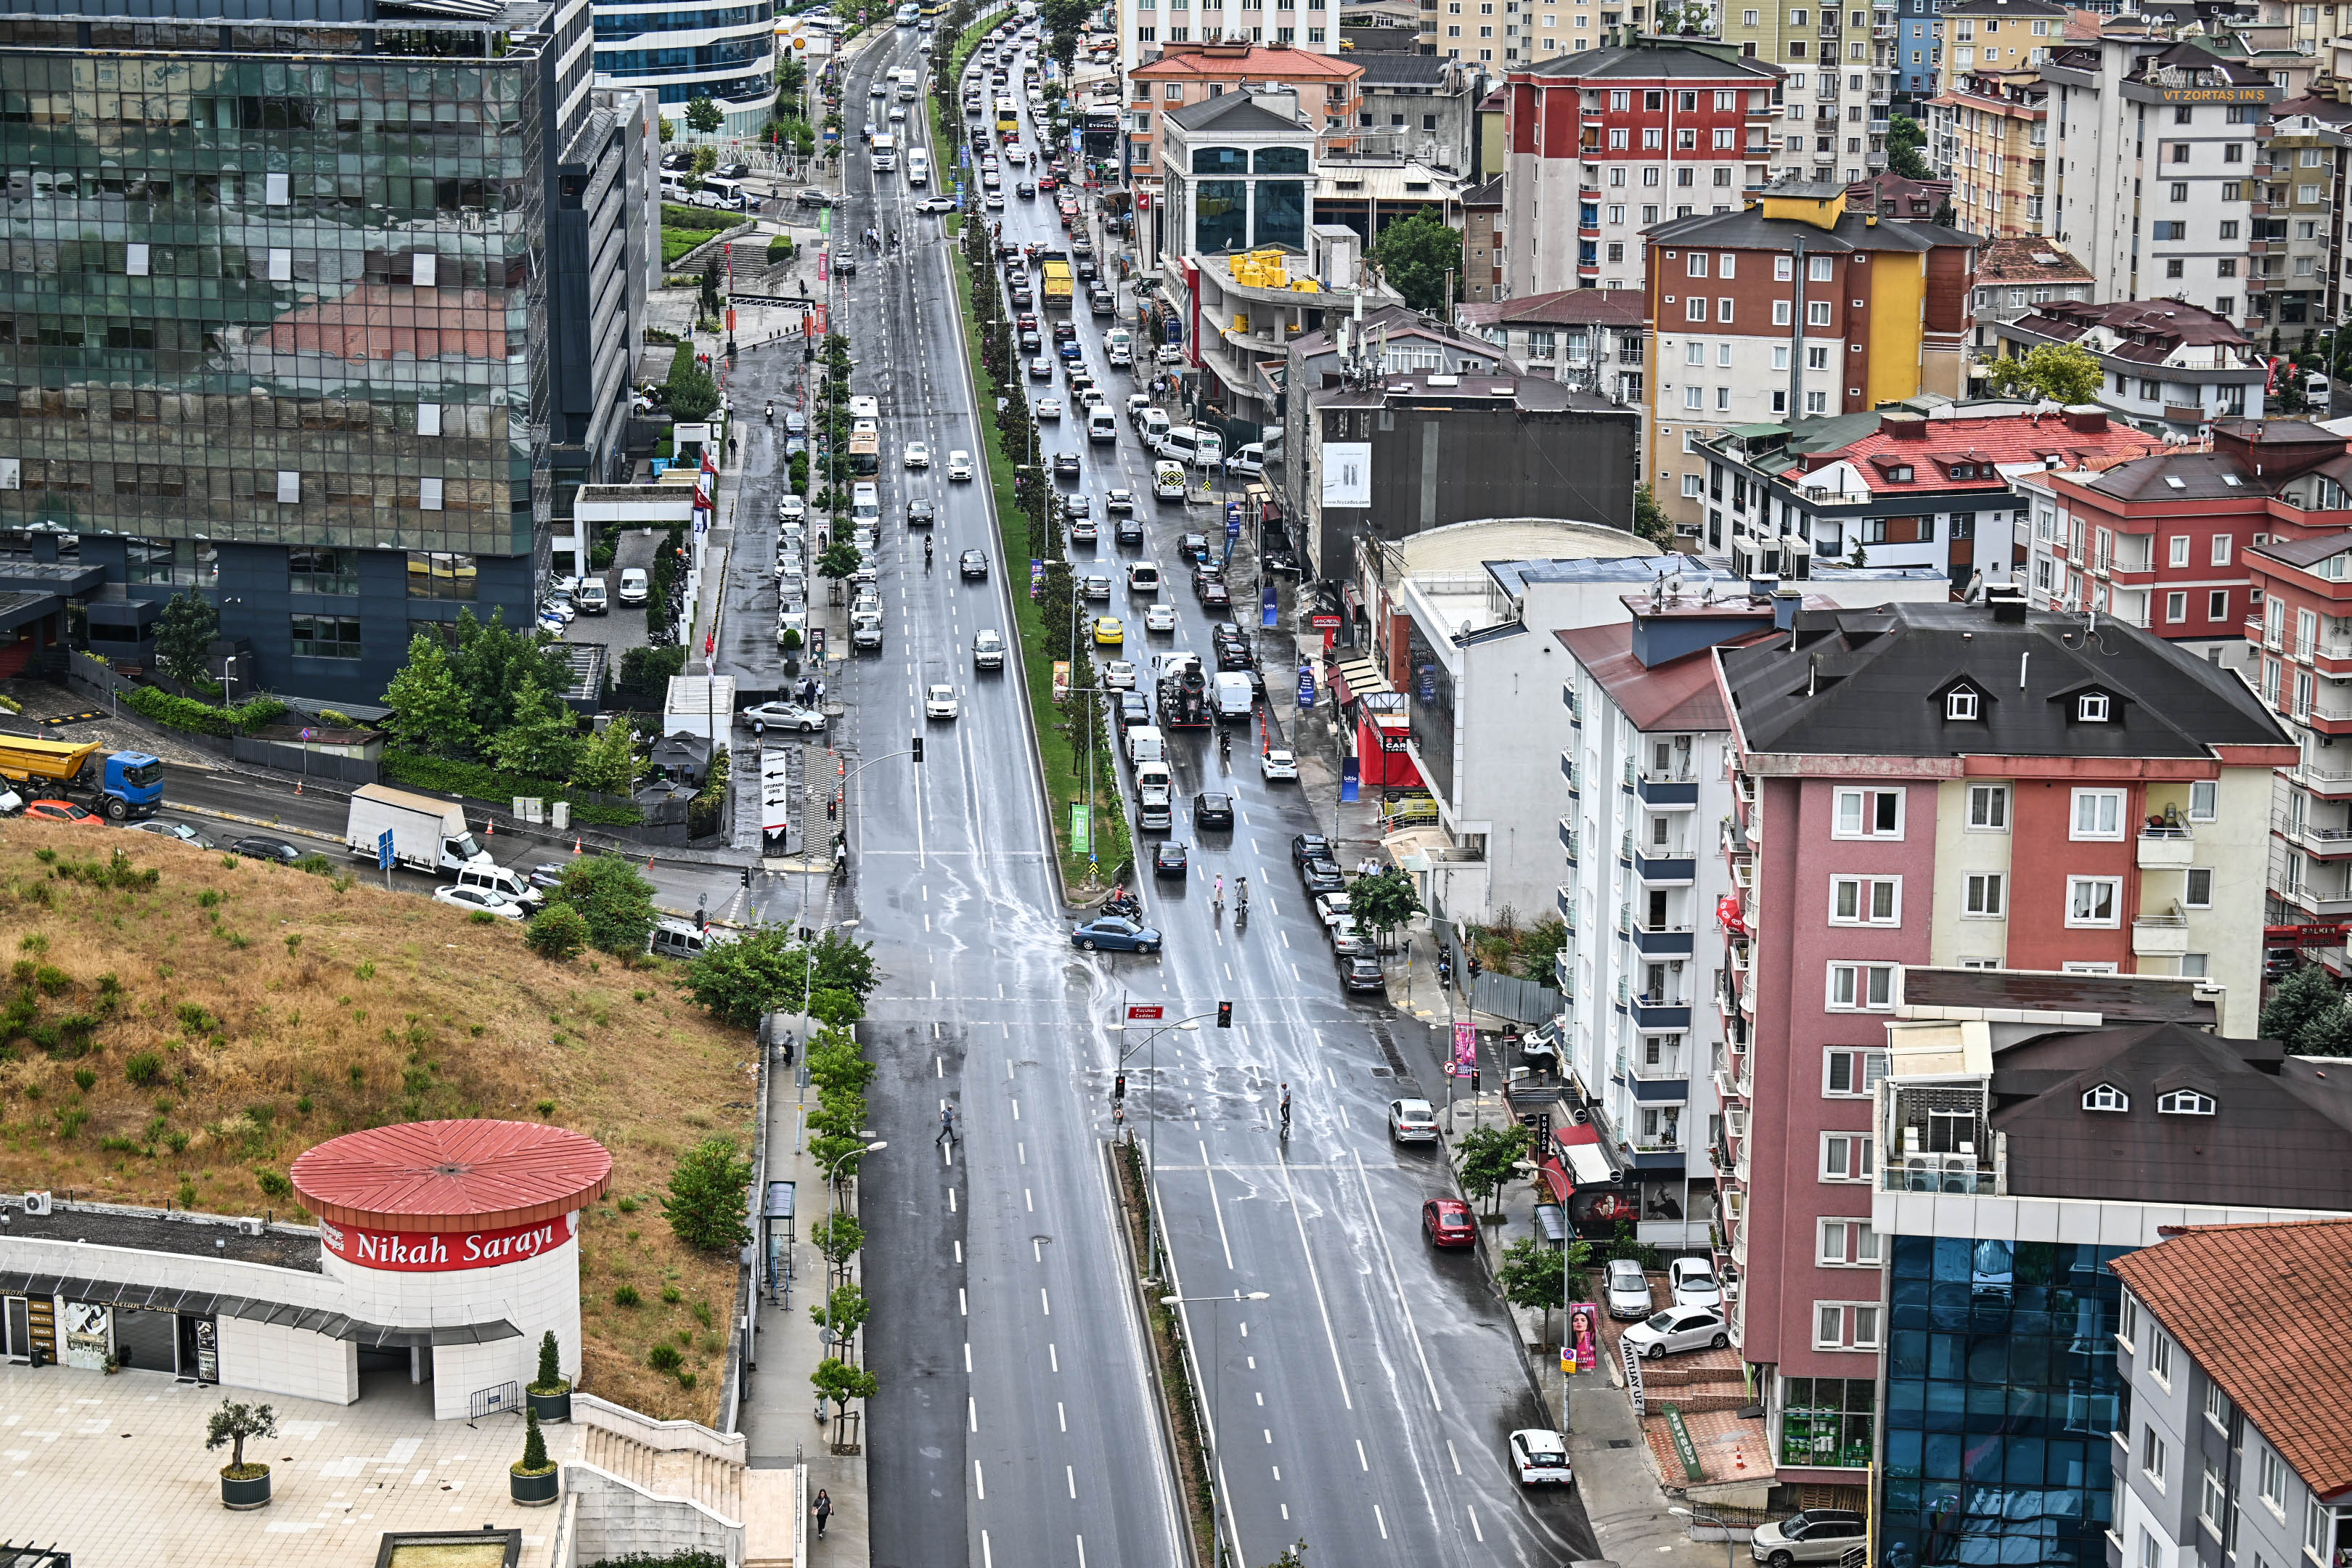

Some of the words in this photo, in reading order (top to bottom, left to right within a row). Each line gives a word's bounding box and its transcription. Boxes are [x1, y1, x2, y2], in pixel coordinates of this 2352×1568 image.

[2164, 90, 2181, 100] VT
[2183, 90, 2235, 102] ZORTAŞ
[356, 1233, 449, 1265] Nikah
[462, 1225, 553, 1262] Sarayı
